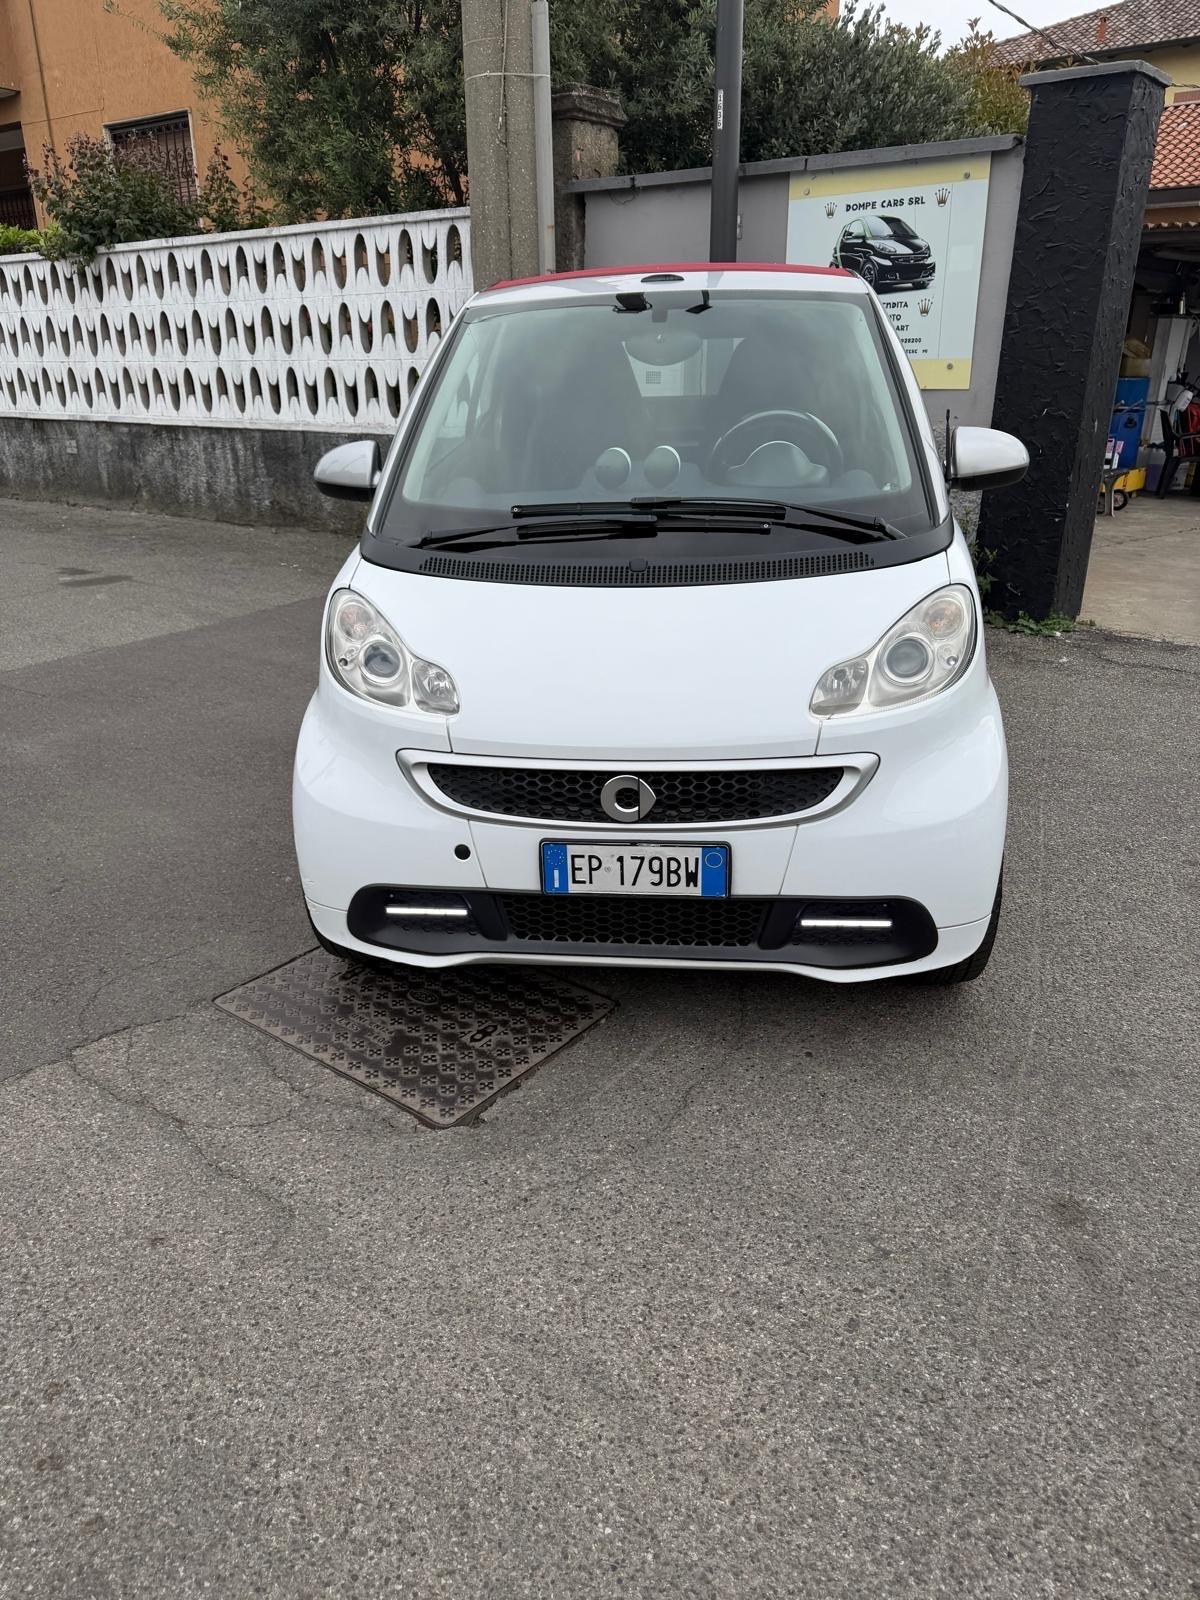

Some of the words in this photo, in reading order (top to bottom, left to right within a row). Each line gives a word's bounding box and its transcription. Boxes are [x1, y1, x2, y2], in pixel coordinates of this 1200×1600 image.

[846, 201, 877, 212] DOMPE
[881, 198, 905, 208] CARS
[909, 196, 926, 205] SRL
[570, 855, 603, 885] EP
[616, 856, 700, 888] 179BW
